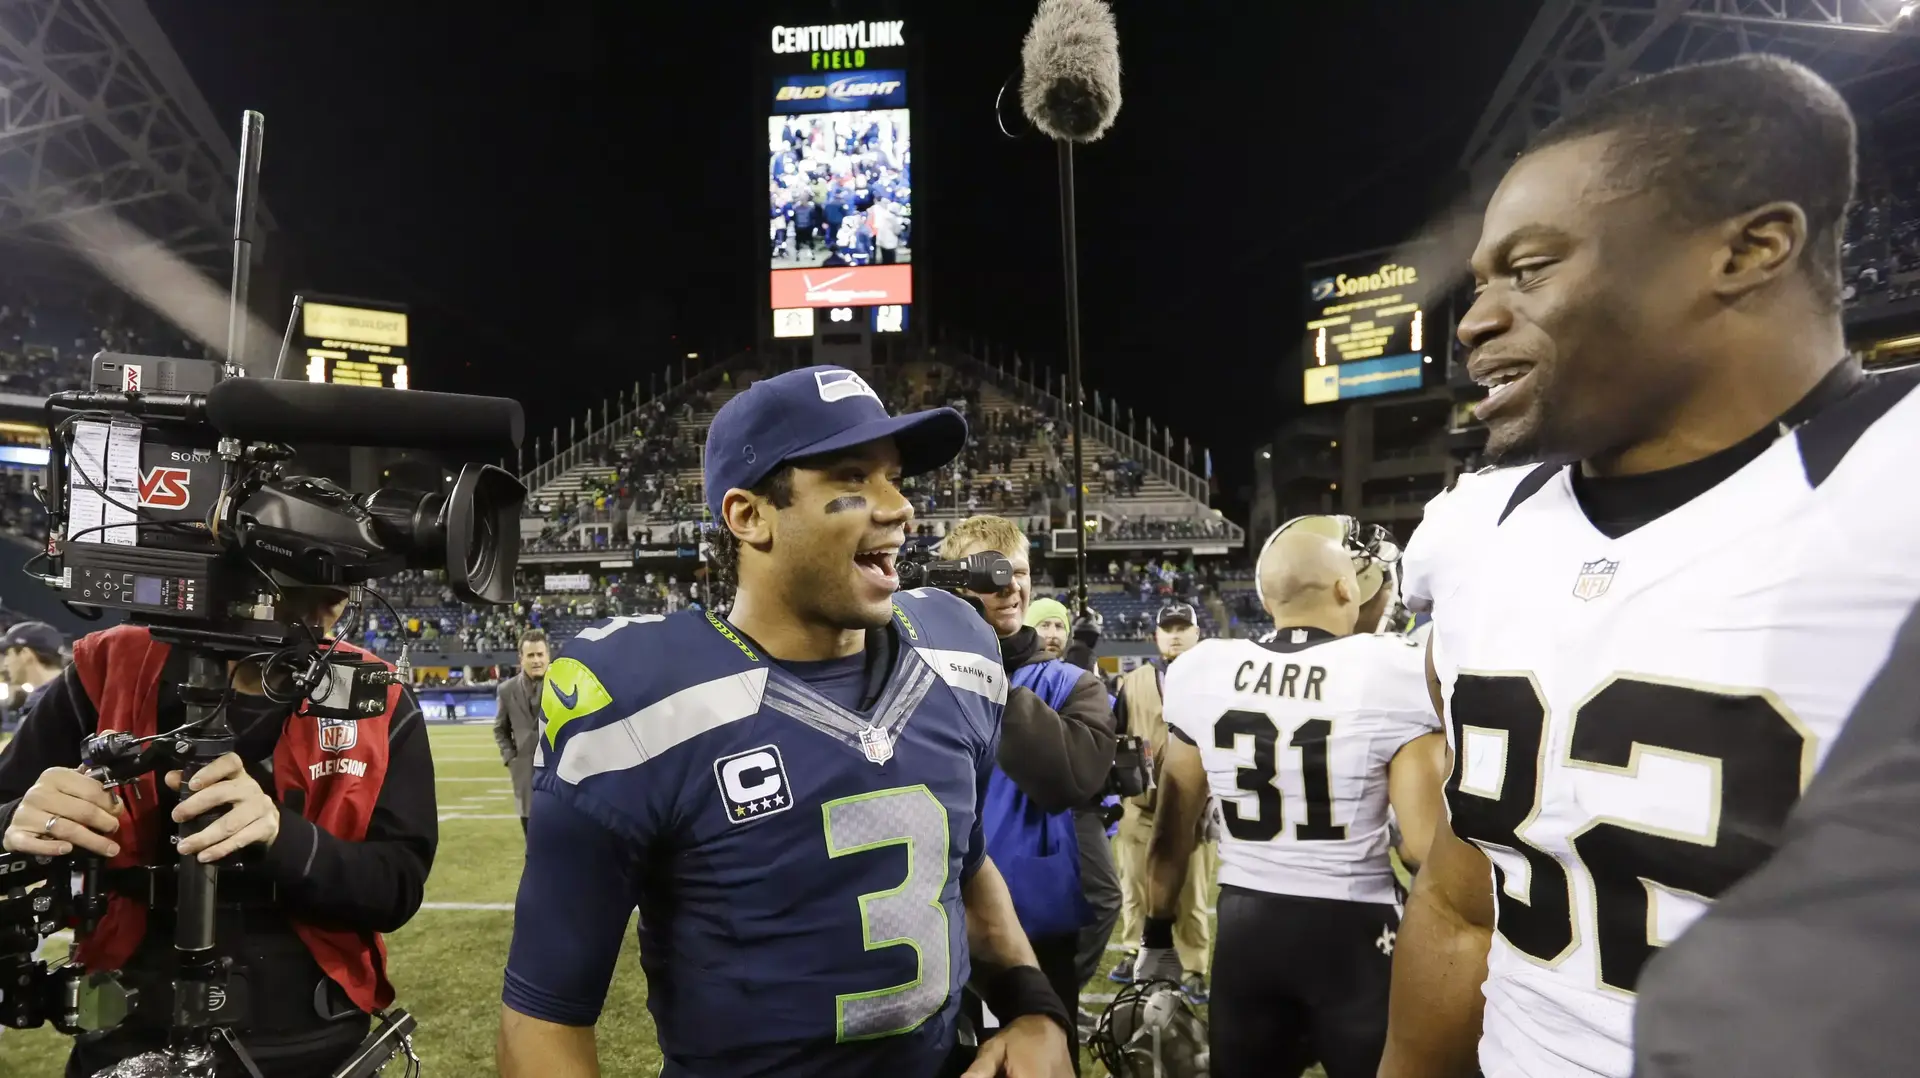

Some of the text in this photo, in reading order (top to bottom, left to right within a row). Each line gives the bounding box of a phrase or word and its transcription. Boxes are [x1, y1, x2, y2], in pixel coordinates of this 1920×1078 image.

[812, 50, 865, 69] FIELD
[1335, 264, 1418, 297] SonoSite
[171, 451, 212, 463] SONY
[256, 540, 293, 557] Canon
[185, 579, 195, 611] LINK
[1577, 577, 1608, 597] NFL
[949, 662, 993, 684] SEAHAWS
[1234, 660, 1327, 701] CARR
[323, 726, 353, 748] NFL
[722, 752, 782, 804] C
[1213, 709, 1349, 842] 31
[1442, 667, 1818, 996] 82
[821, 783, 950, 1044] 3
